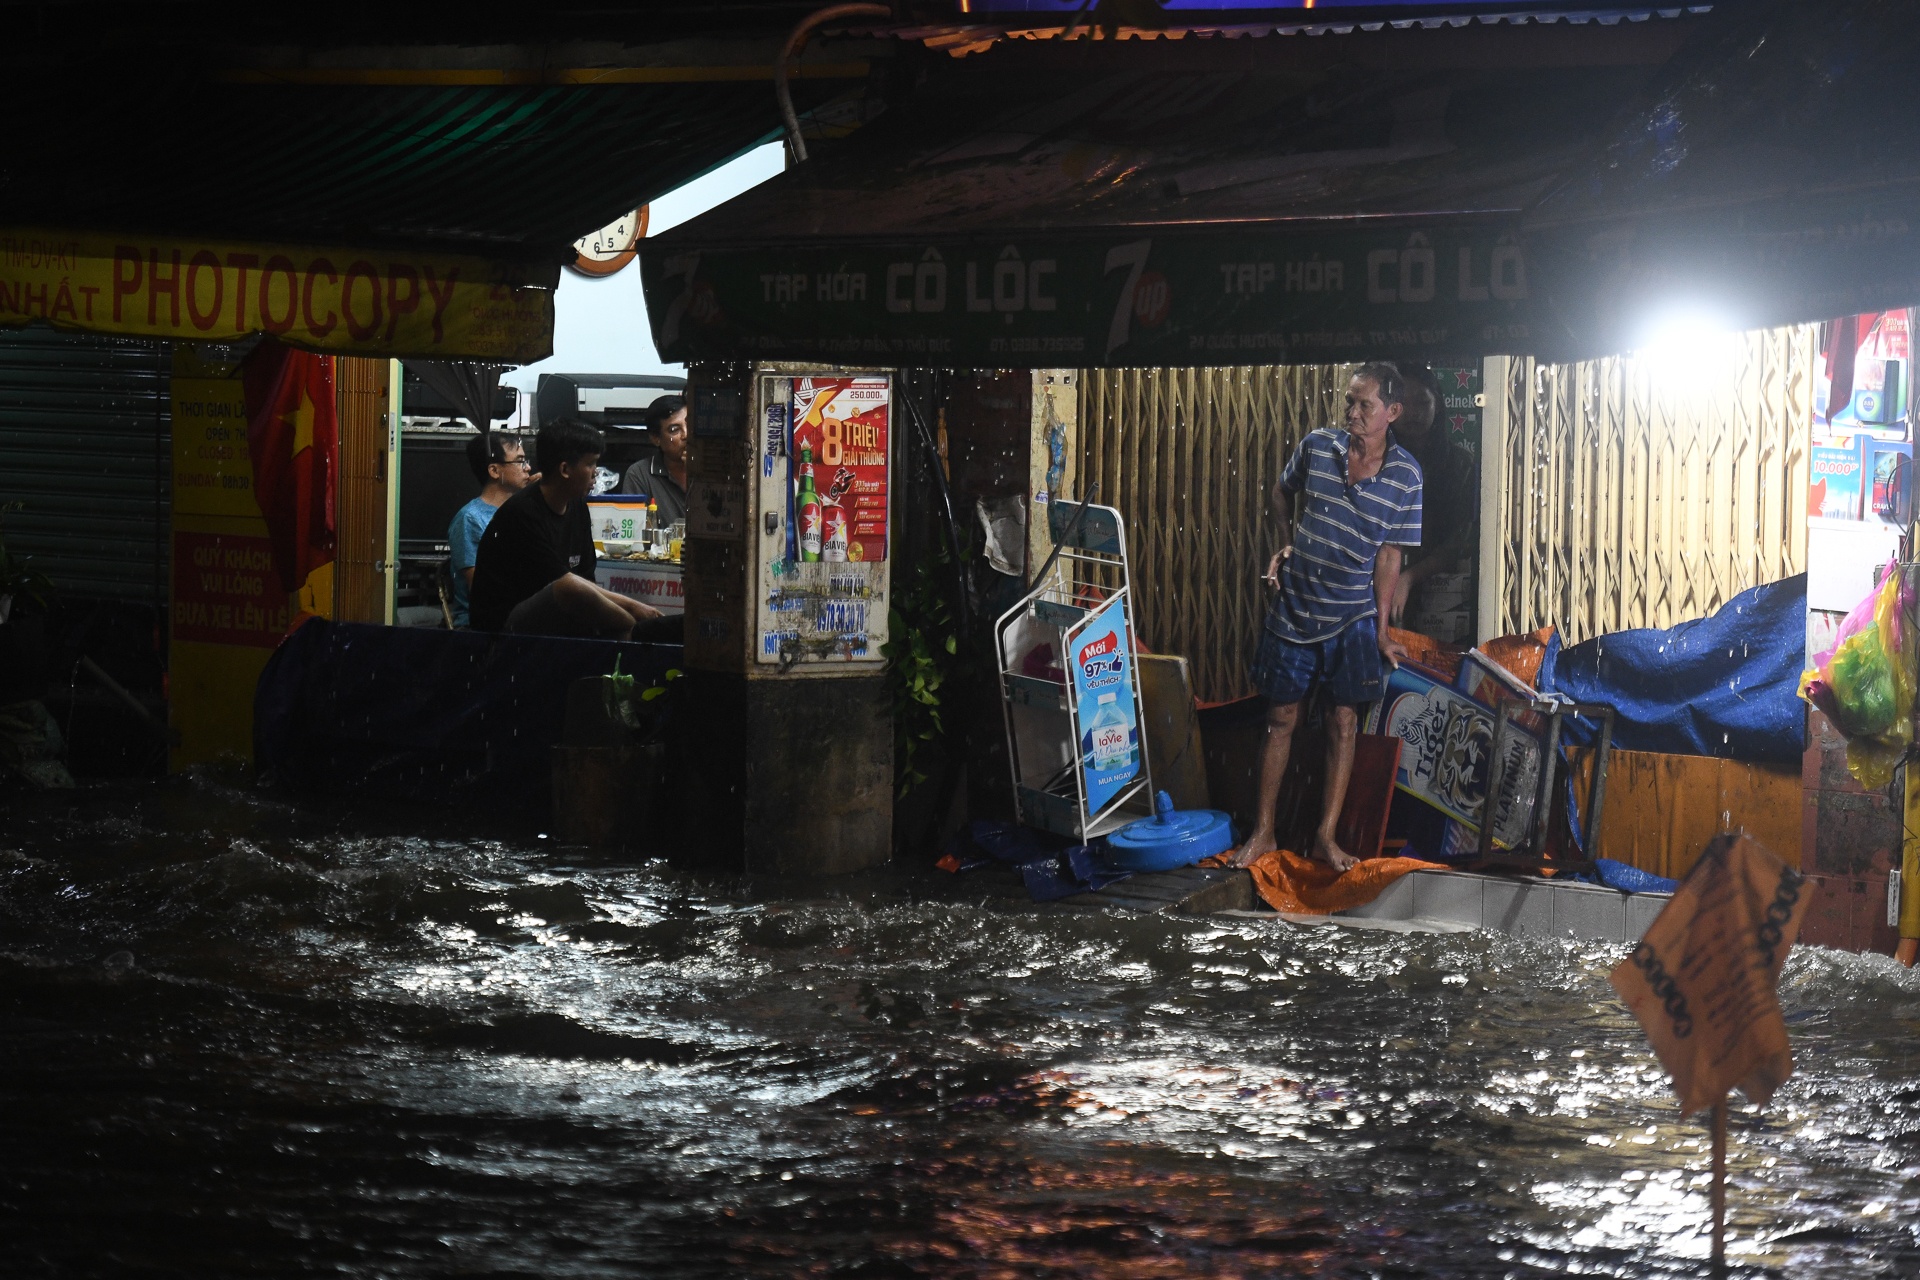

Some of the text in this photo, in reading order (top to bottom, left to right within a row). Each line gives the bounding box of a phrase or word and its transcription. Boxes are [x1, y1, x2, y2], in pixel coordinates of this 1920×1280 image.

[617, 225, 624, 235] 4
[580, 238, 586, 248] 7
[594, 242, 601, 253] 6
[607, 238, 614, 248] 5
[1220, 261, 1275, 300] TẠP
[1284, 252, 1344, 292] HÓA
[1366, 231, 1436, 302] CÔ
[760, 244, 1056, 324] TẠP HÓA CÔ LỘC
[0, 244, 460, 344] NHẤT PHOTOCOPY
[206, 401, 231, 419] GIAN
[235, 399, 248, 418] LÀ
[1443, 394, 1476, 408] einek
[205, 427, 230, 442] OPEN
[822, 417, 843, 466] 8
[844, 421, 880, 452] TRIỆU
[198, 445, 233, 460] CLOSED
[842, 450, 885, 467] GIẢI THƯỞNG
[803, 533, 811, 541] BIA
[824, 541, 836, 551] BIA
[224, 545, 272, 571] KHÁCH
[199, 569, 264, 597] VUI LÒNG
[609, 576, 665, 596] PHOTOCOPY
[211, 605, 231, 629] XE
[233, 600, 264, 631] LÊN
[1085, 641, 1106, 658] Mới
[1084, 661, 1107, 678] 97%
[1087, 680, 1100, 689] YÊU
[1414, 700, 1448, 780] Tiger
[1098, 771, 1132, 786] MUA NGAY
[1494, 739, 1525, 832] PLATINUM
